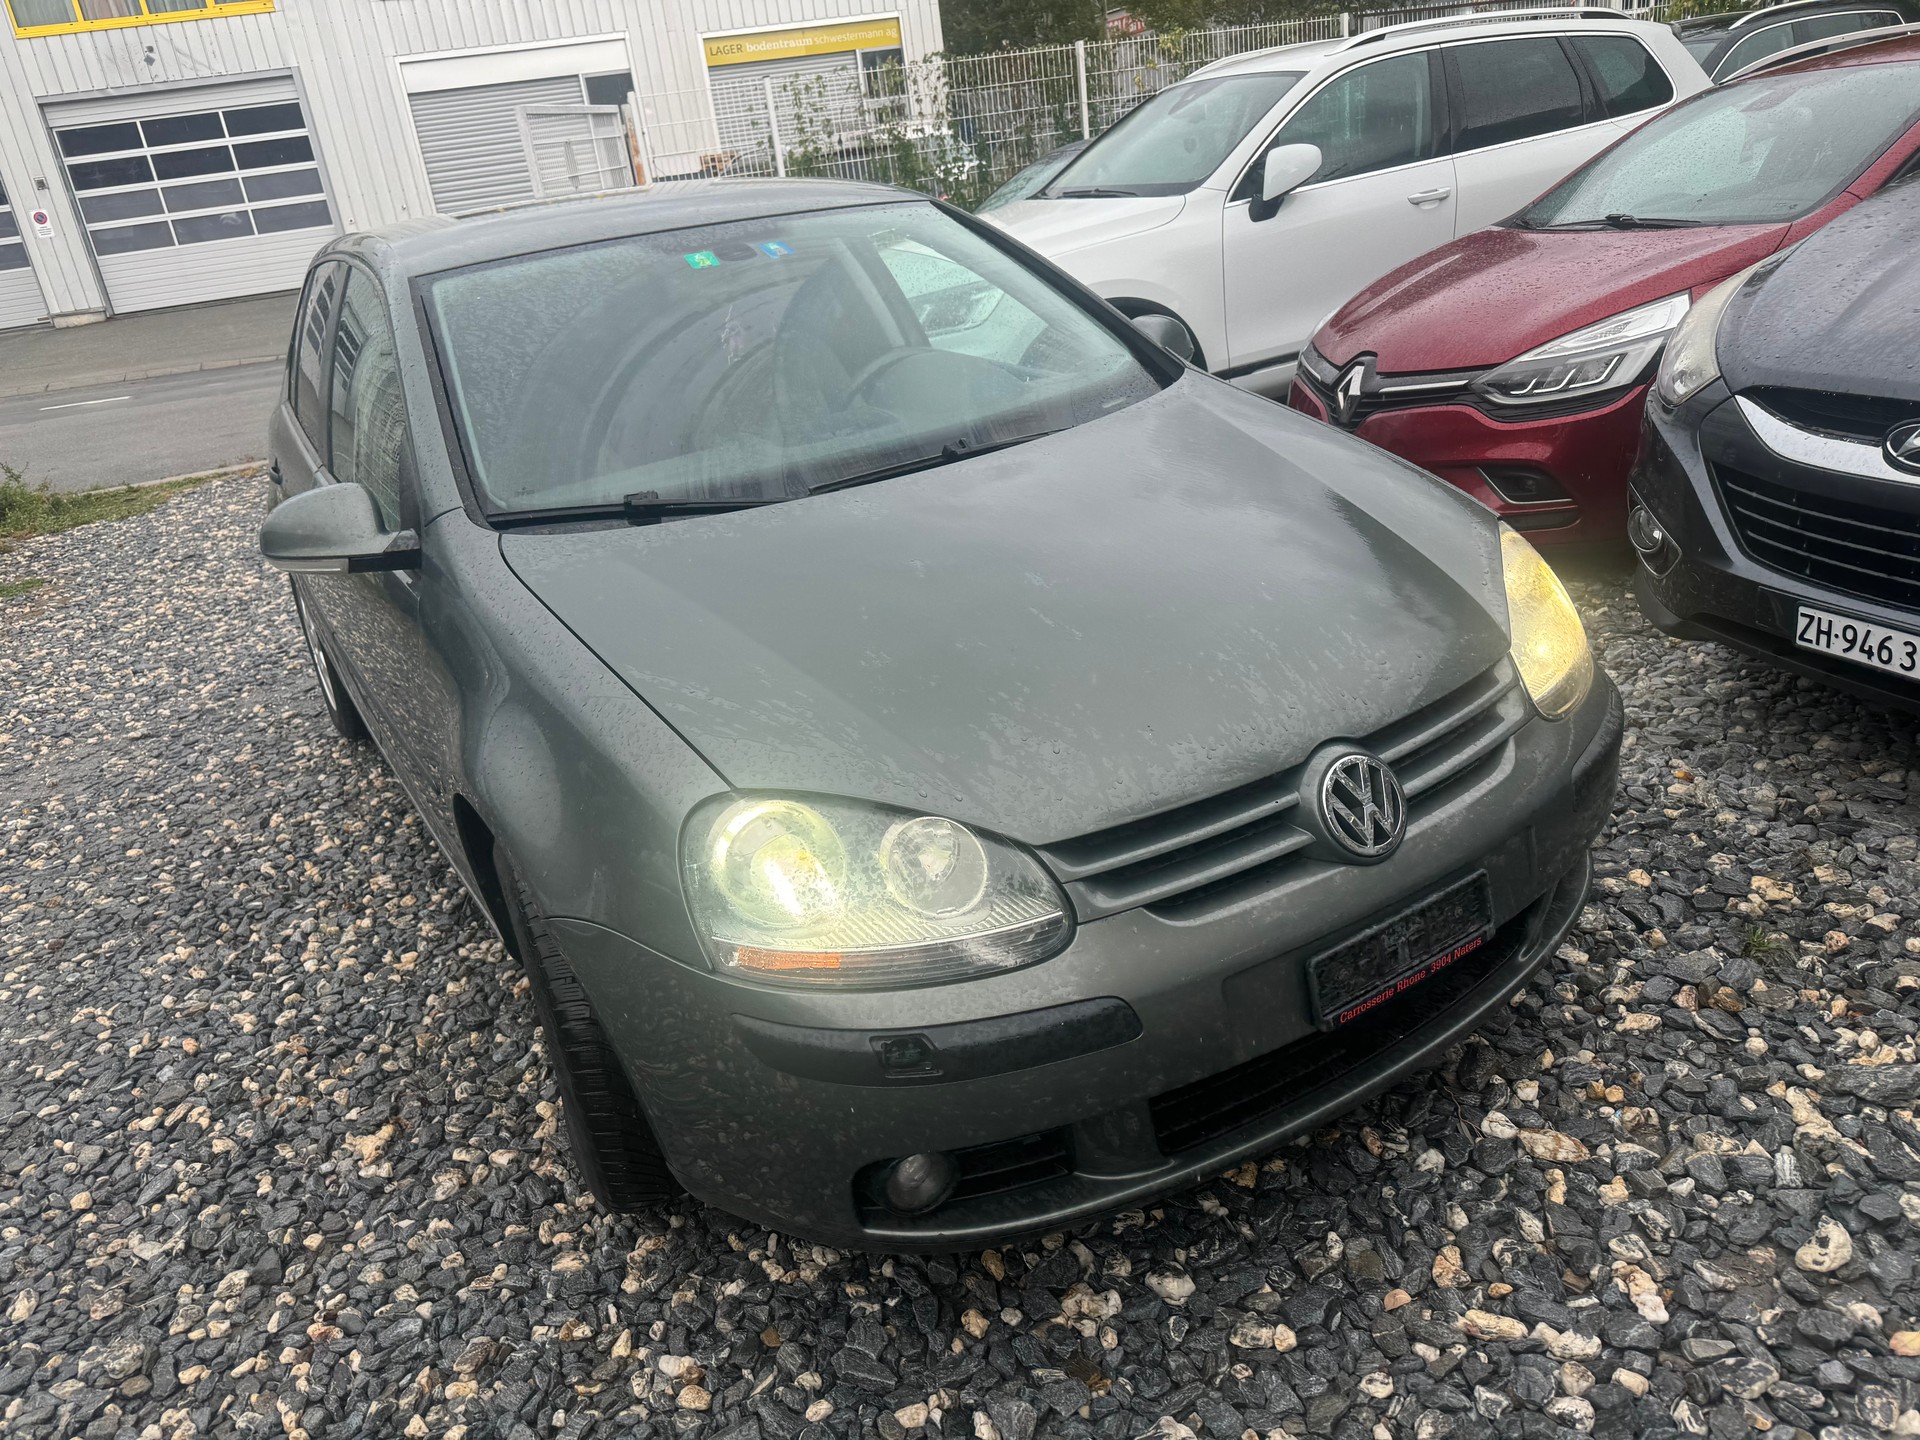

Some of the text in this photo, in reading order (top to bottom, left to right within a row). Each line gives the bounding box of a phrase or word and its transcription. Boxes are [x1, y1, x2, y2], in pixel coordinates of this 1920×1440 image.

[709, 27, 898, 56] LAGER bodentraum schwestermann ag
[1339, 936, 1482, 1024] Carrosserie Rhone 3904 Naters
